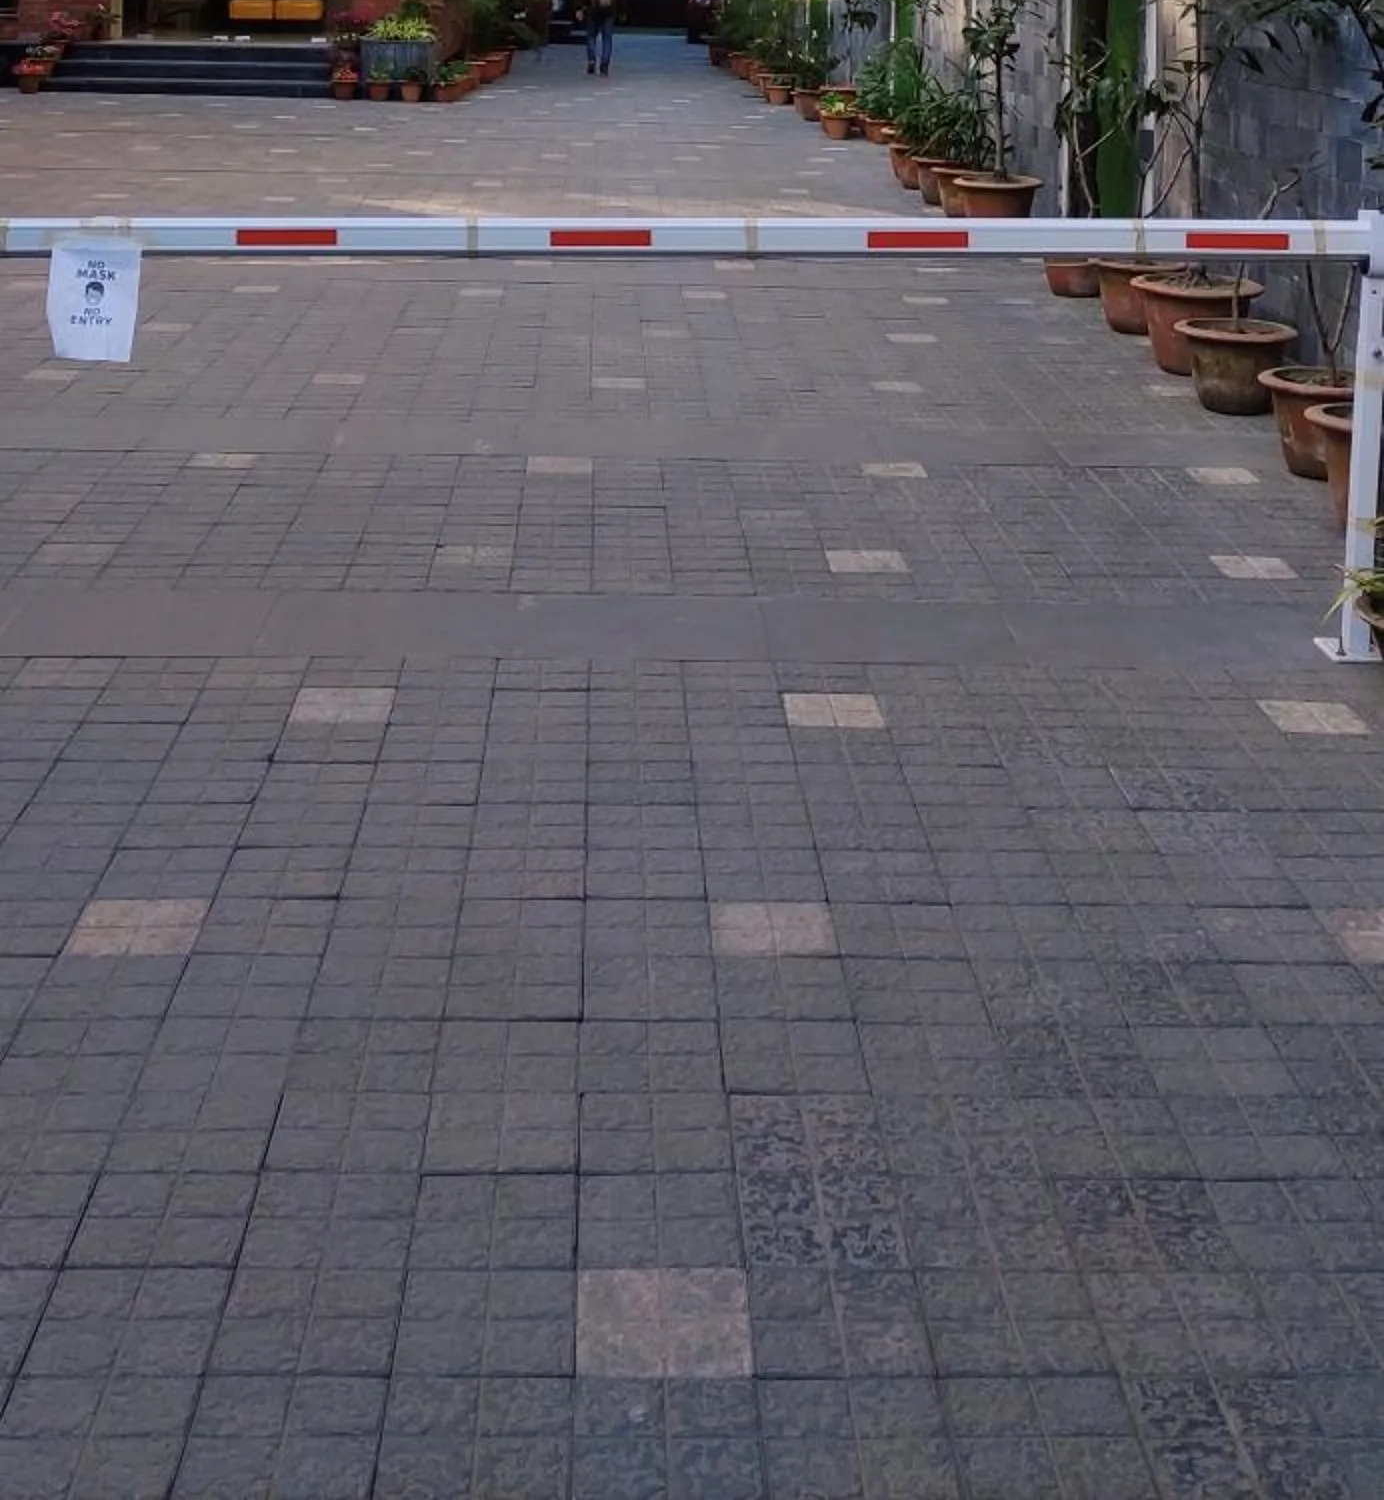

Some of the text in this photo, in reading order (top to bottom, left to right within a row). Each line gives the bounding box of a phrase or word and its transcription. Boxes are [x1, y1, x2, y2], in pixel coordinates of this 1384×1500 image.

[88, 260, 105, 269] NO
[77, 269, 116, 280] MASK
[84, 307, 101, 316] NO
[70, 315, 113, 325] ENTRY
